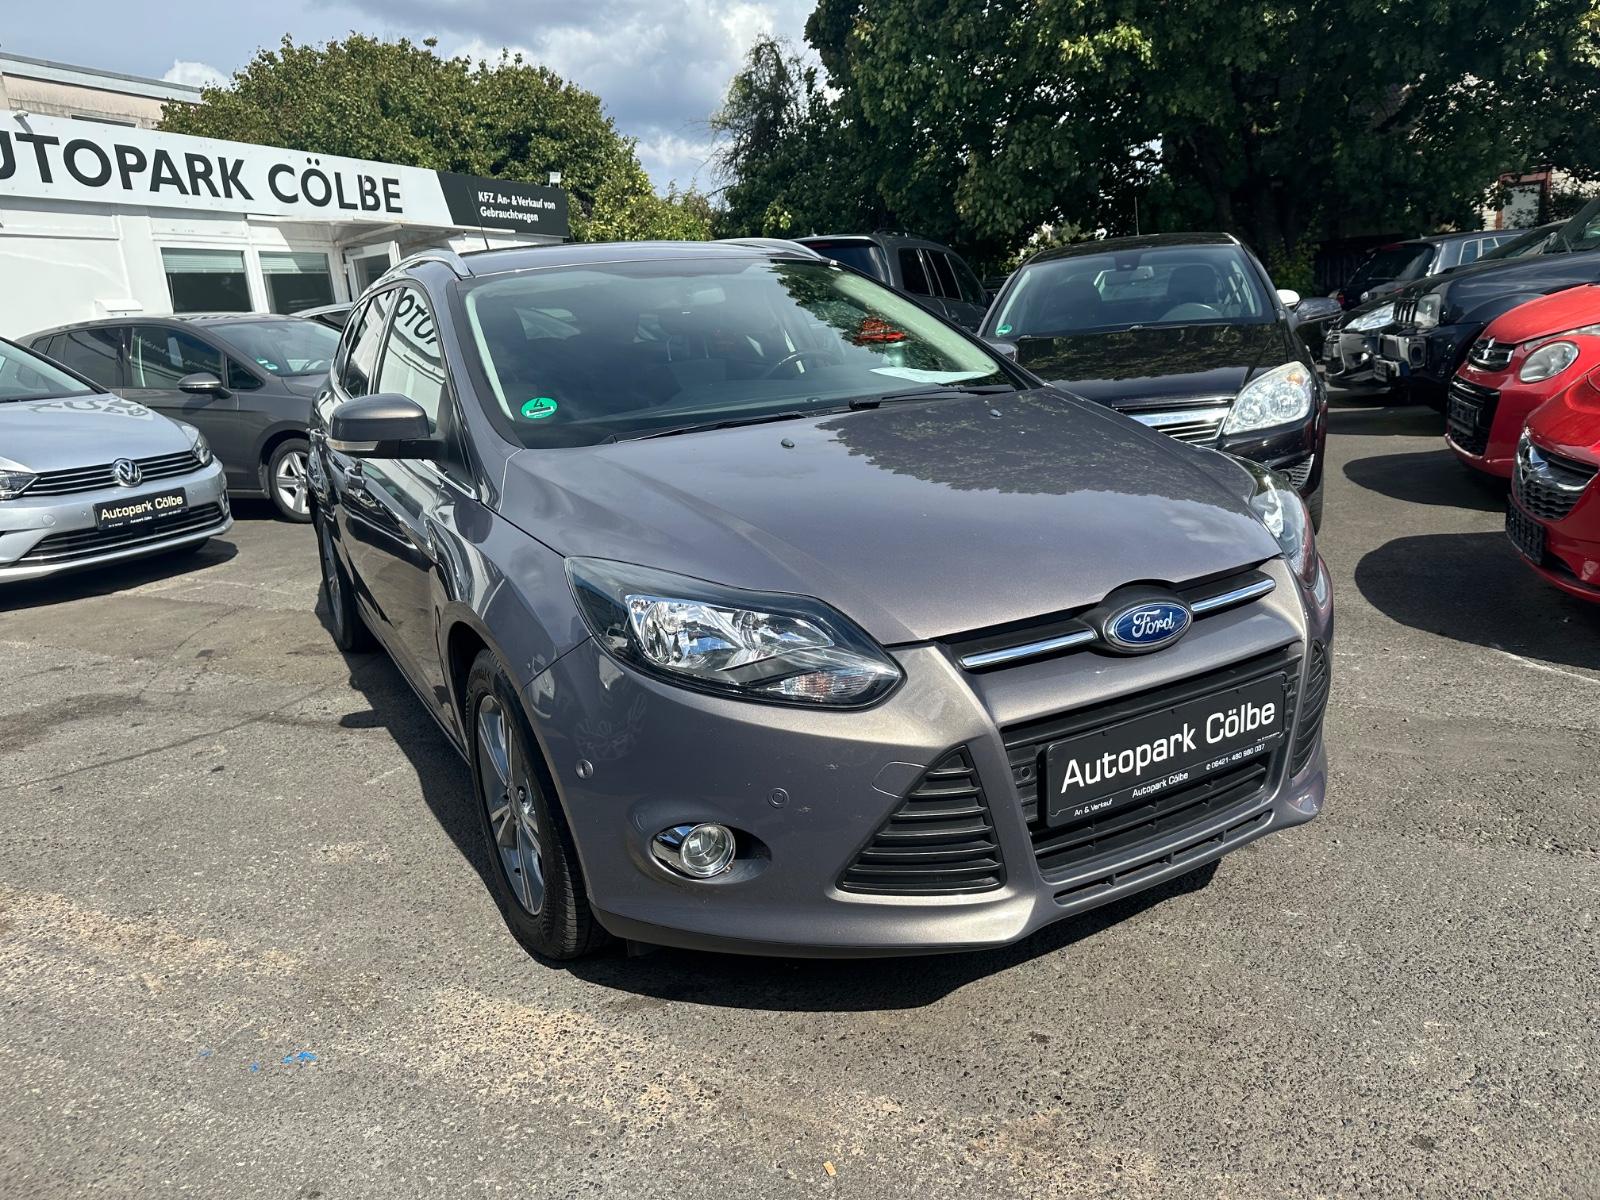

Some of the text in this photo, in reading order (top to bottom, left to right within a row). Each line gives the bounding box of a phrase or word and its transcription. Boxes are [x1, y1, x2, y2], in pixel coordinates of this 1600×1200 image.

[268, 158, 403, 214] CÖLBE
[478, 191, 495, 203] KFZ
[517, 196, 543, 208] Verkauf
[543, 201, 556, 210] von
[480, 206, 539, 224] Gebrauchtwagen
[101, 500, 153, 521] Autopark
[154, 496, 183, 510] Cölbe
[1131, 609, 1175, 638] Ford
[1061, 702, 1276, 794] Autopark Cölbe
[1132, 772, 1189, 798] Autopark Cölbe
